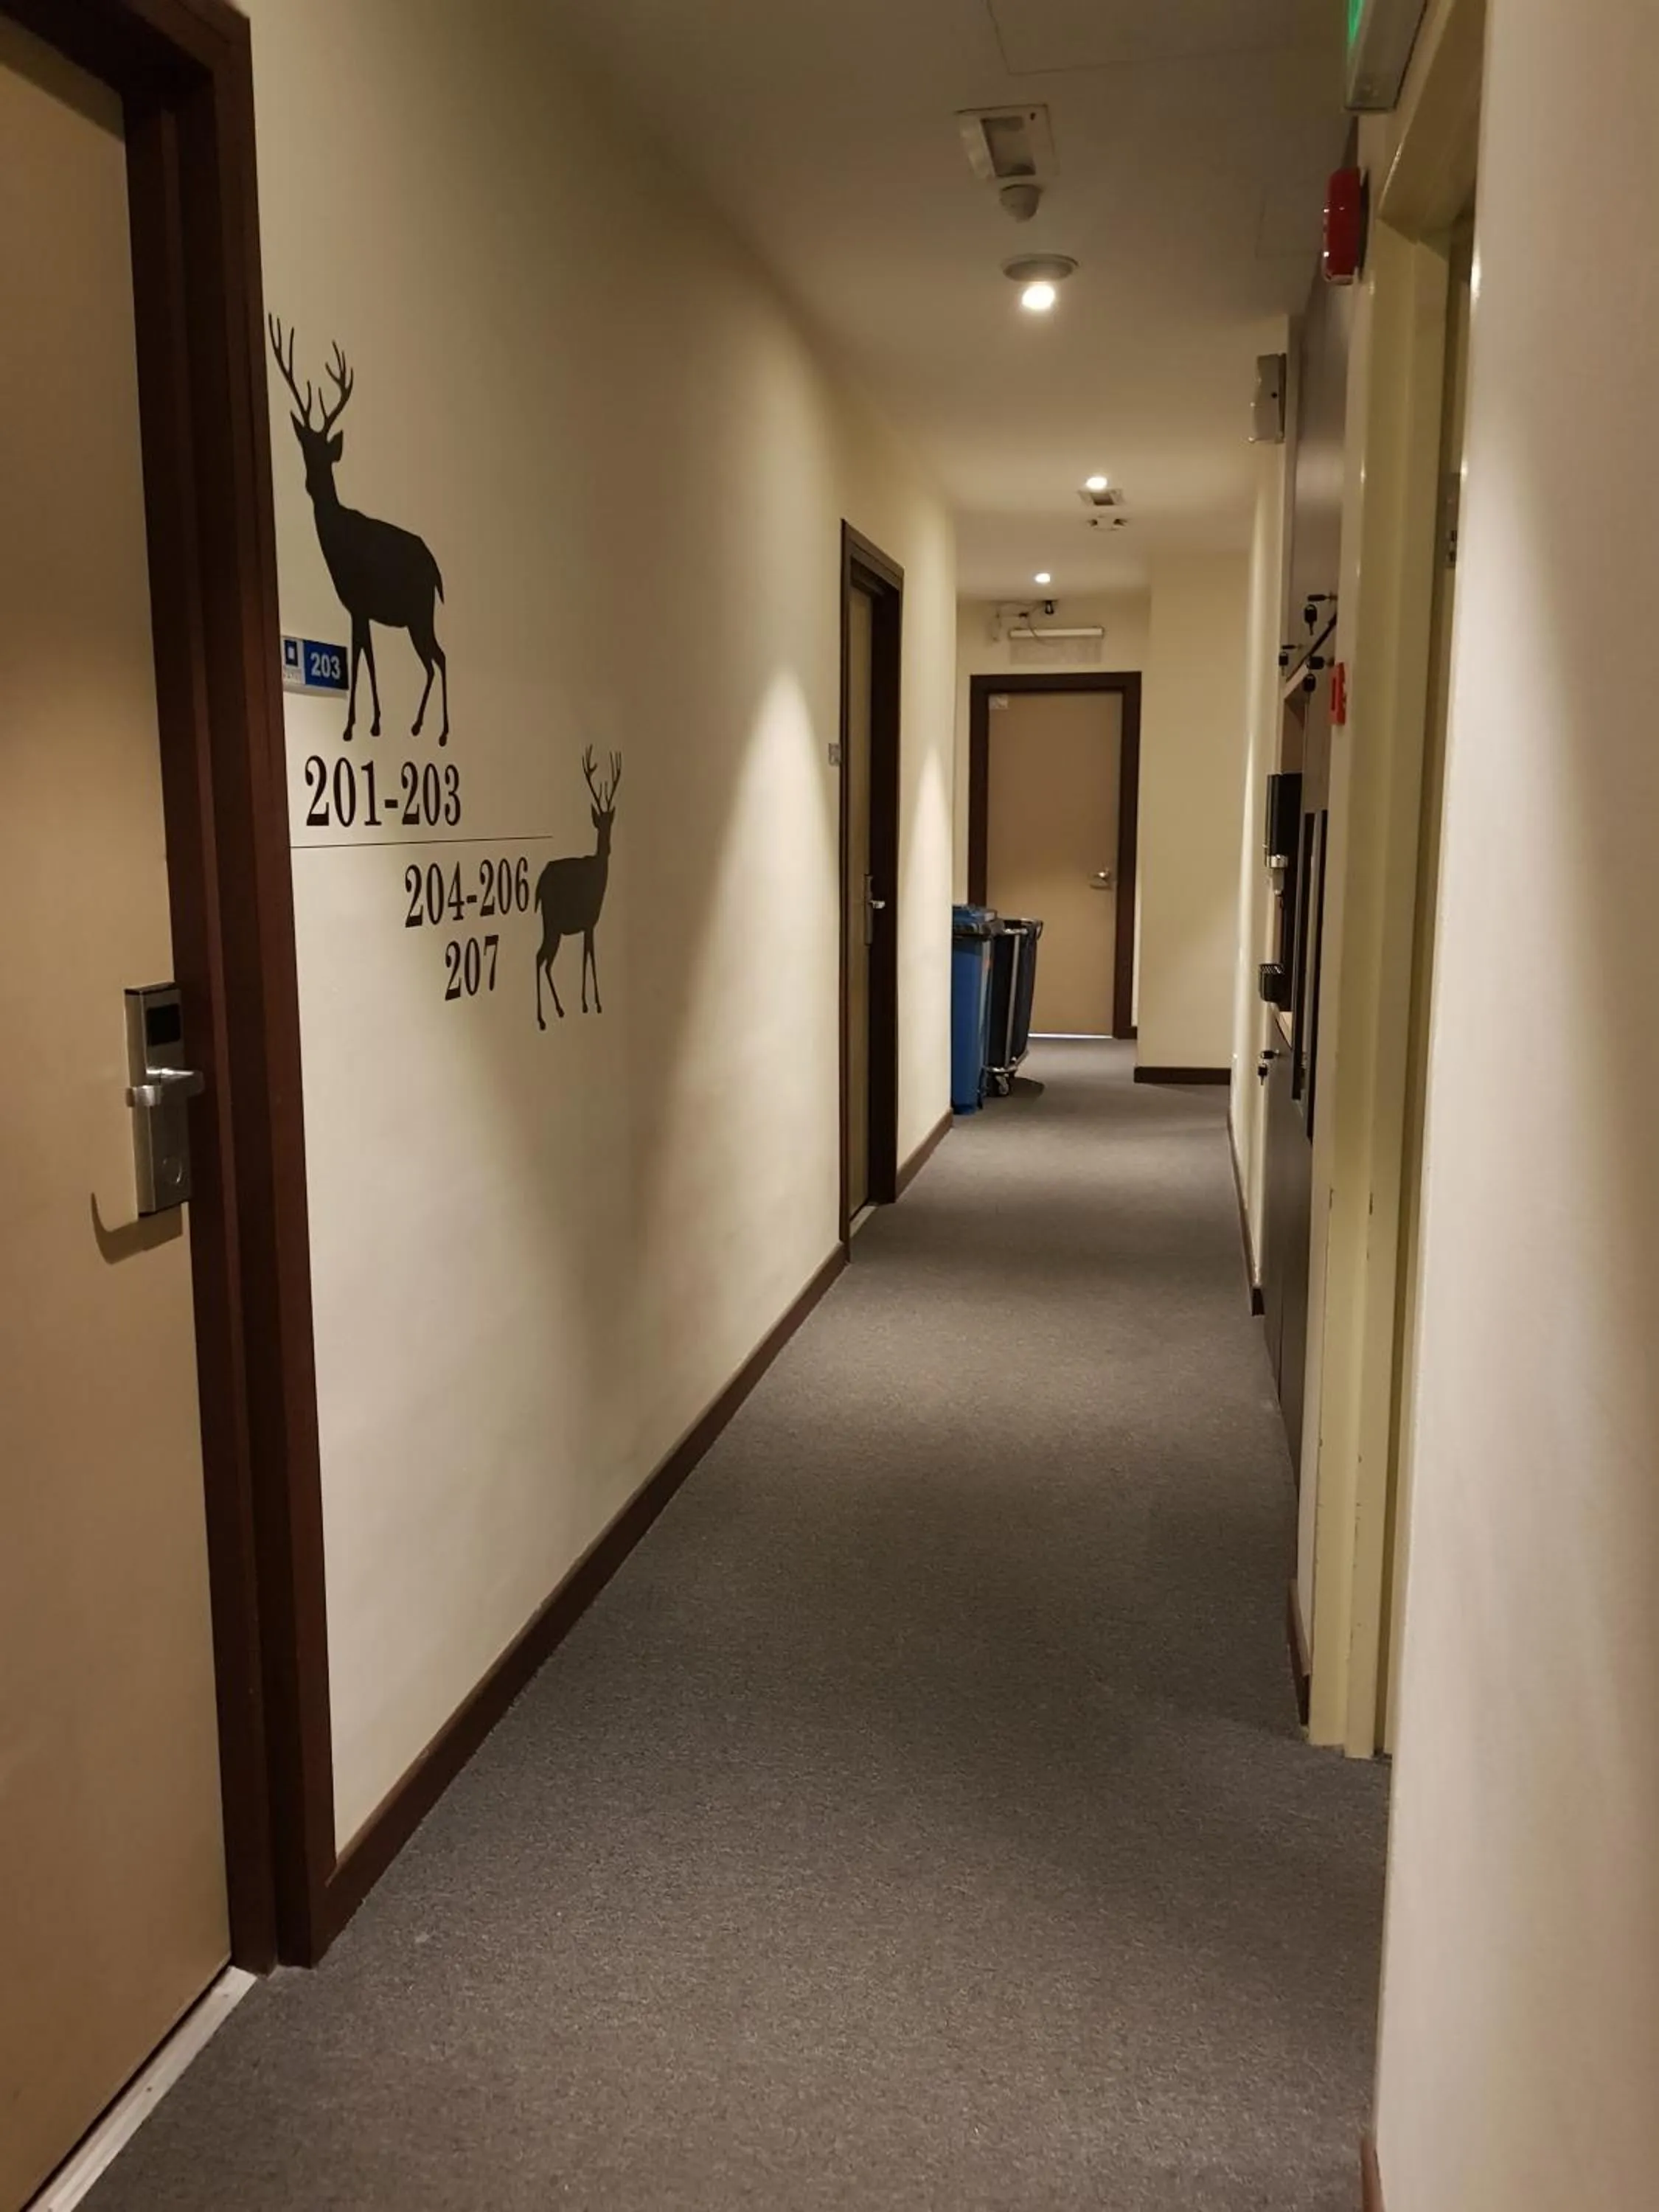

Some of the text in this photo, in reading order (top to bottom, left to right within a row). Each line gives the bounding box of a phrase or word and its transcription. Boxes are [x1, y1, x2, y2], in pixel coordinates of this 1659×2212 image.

[310, 652, 341, 679] 203
[305, 755, 461, 827] 201-203
[405, 857, 529, 928] 204-206
[445, 934, 499, 1001] 207
